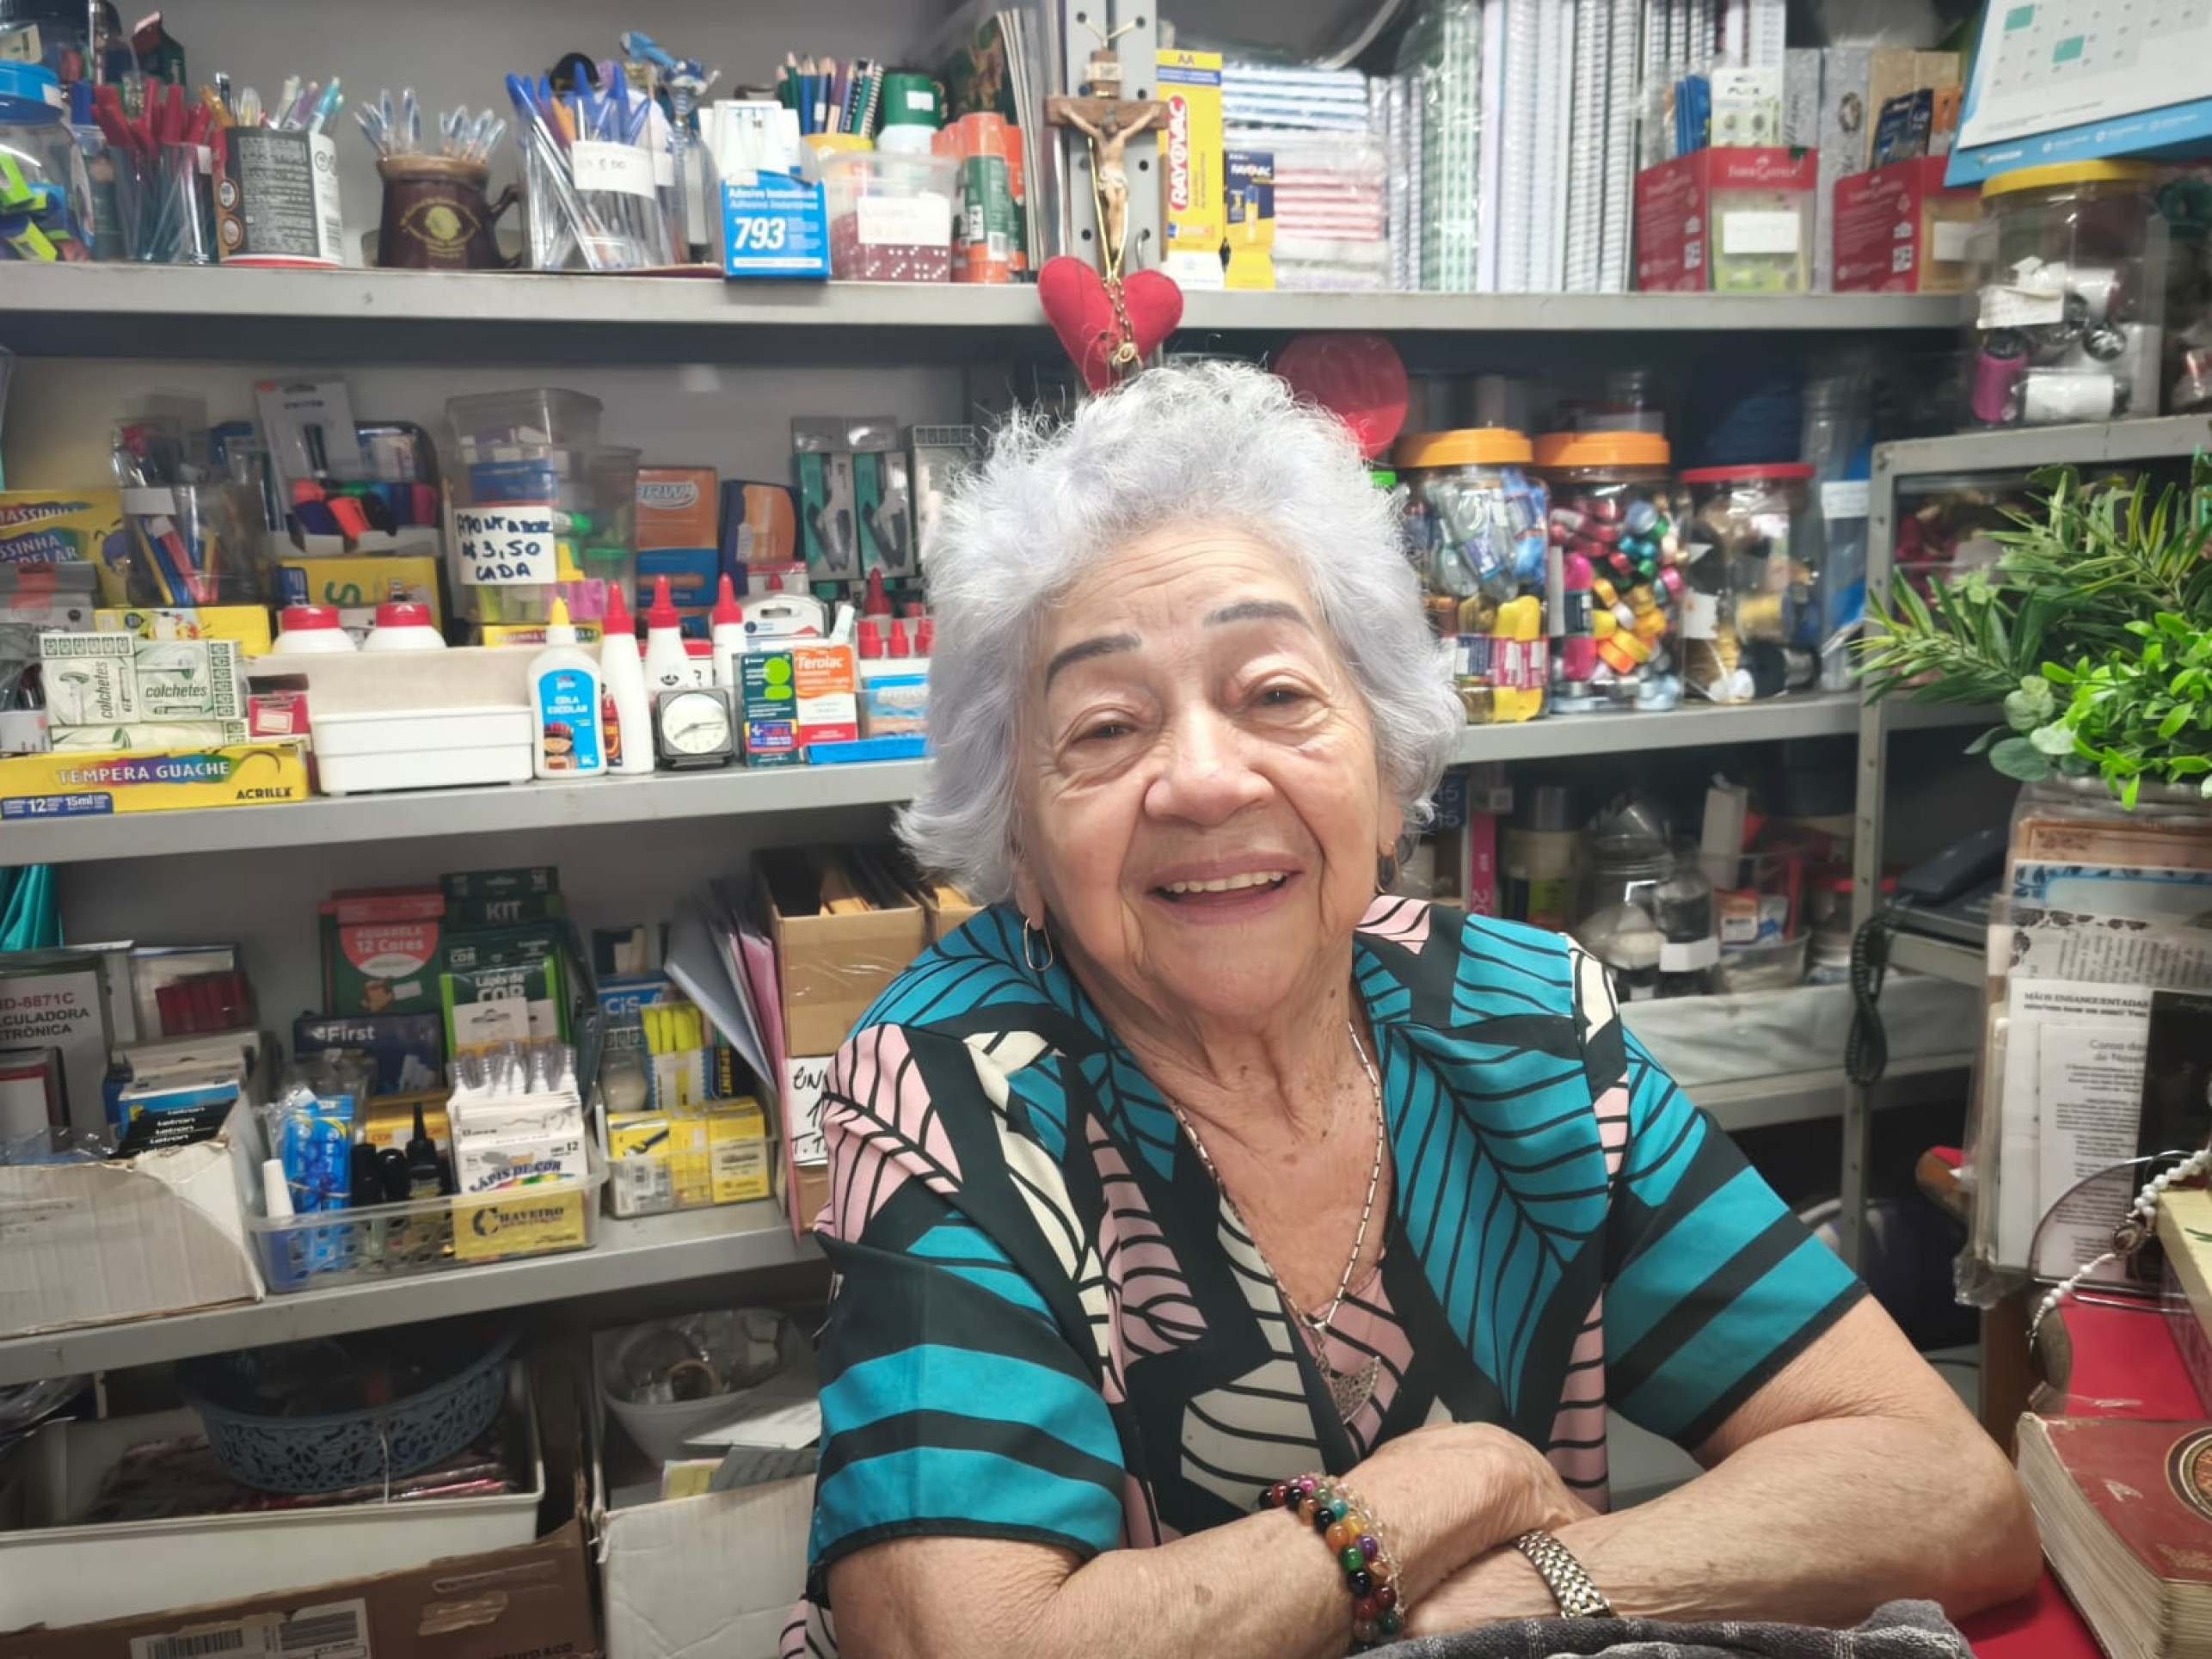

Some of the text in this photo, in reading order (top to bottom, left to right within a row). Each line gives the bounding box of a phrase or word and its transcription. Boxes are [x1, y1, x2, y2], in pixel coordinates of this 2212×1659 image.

[1177, 54, 1195, 65] AA
[1170, 100, 1188, 207] RAYOVAC
[734, 217, 787, 249] 793
[482, 540, 541, 559] 3,50
[476, 562, 531, 581] CADA
[796, 656, 845, 669] Terolac
[95, 661, 114, 719] colchetes
[145, 684, 207, 698] colchetes
[58, 761, 230, 786] TEMPERA GUACHE
[29, 799, 48, 813] 12
[65, 796, 95, 808] 15ml
[486, 900, 521, 920] KIT
[356, 938, 424, 954] 12 Cores
[567, 1141, 579, 1151] 12
